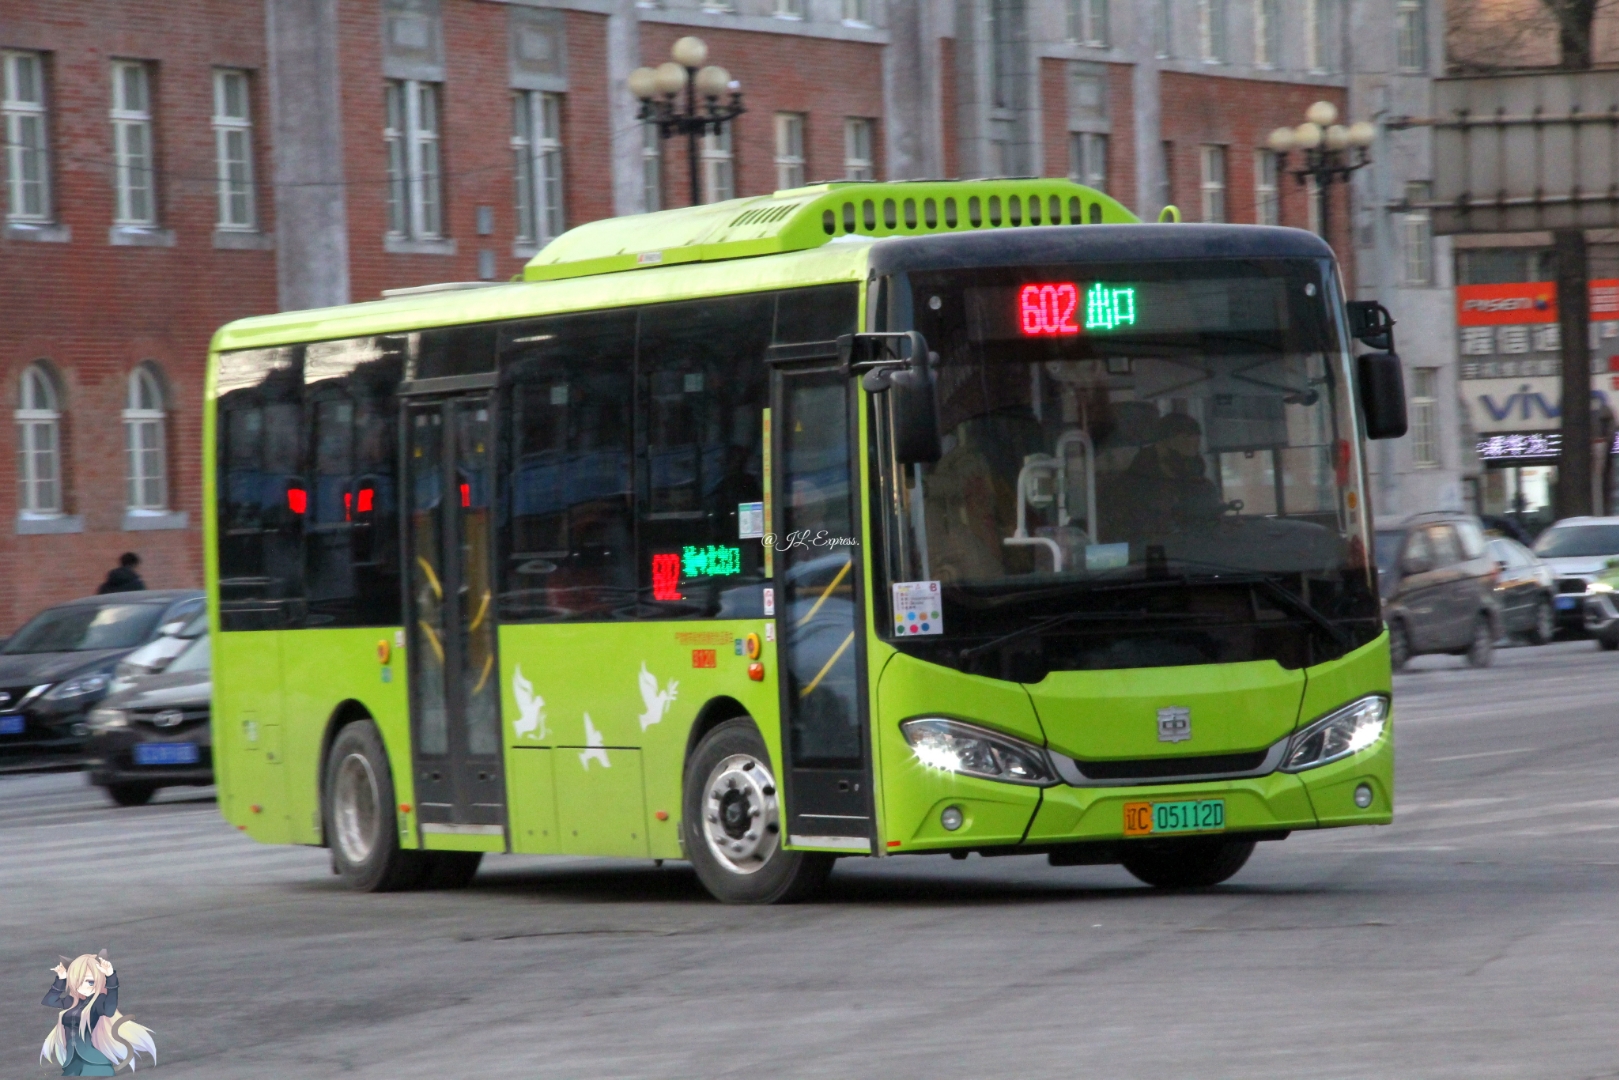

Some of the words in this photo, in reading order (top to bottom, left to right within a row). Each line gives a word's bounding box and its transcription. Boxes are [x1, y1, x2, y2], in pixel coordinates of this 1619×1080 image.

[1020, 284, 1079, 334] 602
[1085, 282, 1135, 330] 出口
[1157, 803, 1224, 829] 05112D
